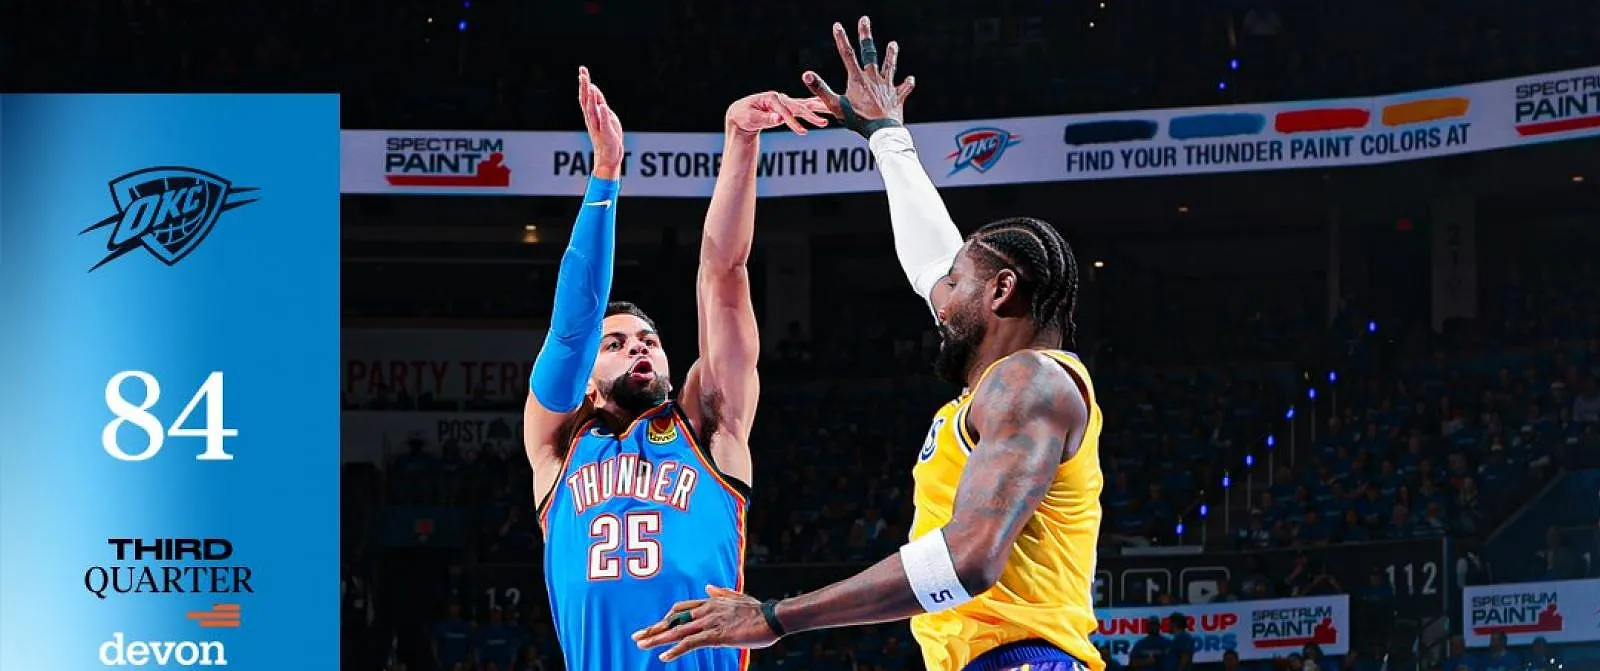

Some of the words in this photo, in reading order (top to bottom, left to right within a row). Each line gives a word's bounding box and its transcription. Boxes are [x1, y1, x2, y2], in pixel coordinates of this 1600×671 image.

[1515, 76, 1600, 99] SPECTR
[386, 137, 503, 151] SPECTRUM
[1066, 150, 1115, 173] FIND
[1121, 146, 1177, 170] YOUR
[1183, 139, 1284, 166] THUNDER
[1290, 134, 1354, 161] PAINT
[1360, 127, 1441, 157] COLORS
[1446, 122, 1472, 147] AT
[385, 153, 482, 174] PAINT
[347, 360, 449, 395] PARTY
[437, 418, 486, 443] POST
[566, 452, 698, 516] THUNDER
[586, 509, 664, 582] 25
[1384, 561, 1438, 597] 112
[1471, 591, 1558, 608] SPECTRUM
[1202, 612, 1238, 632] UP
[1251, 606, 1333, 621] SPECTRUM
[1471, 606, 1542, 626] PAINT
[1251, 619, 1317, 639] PAINT
